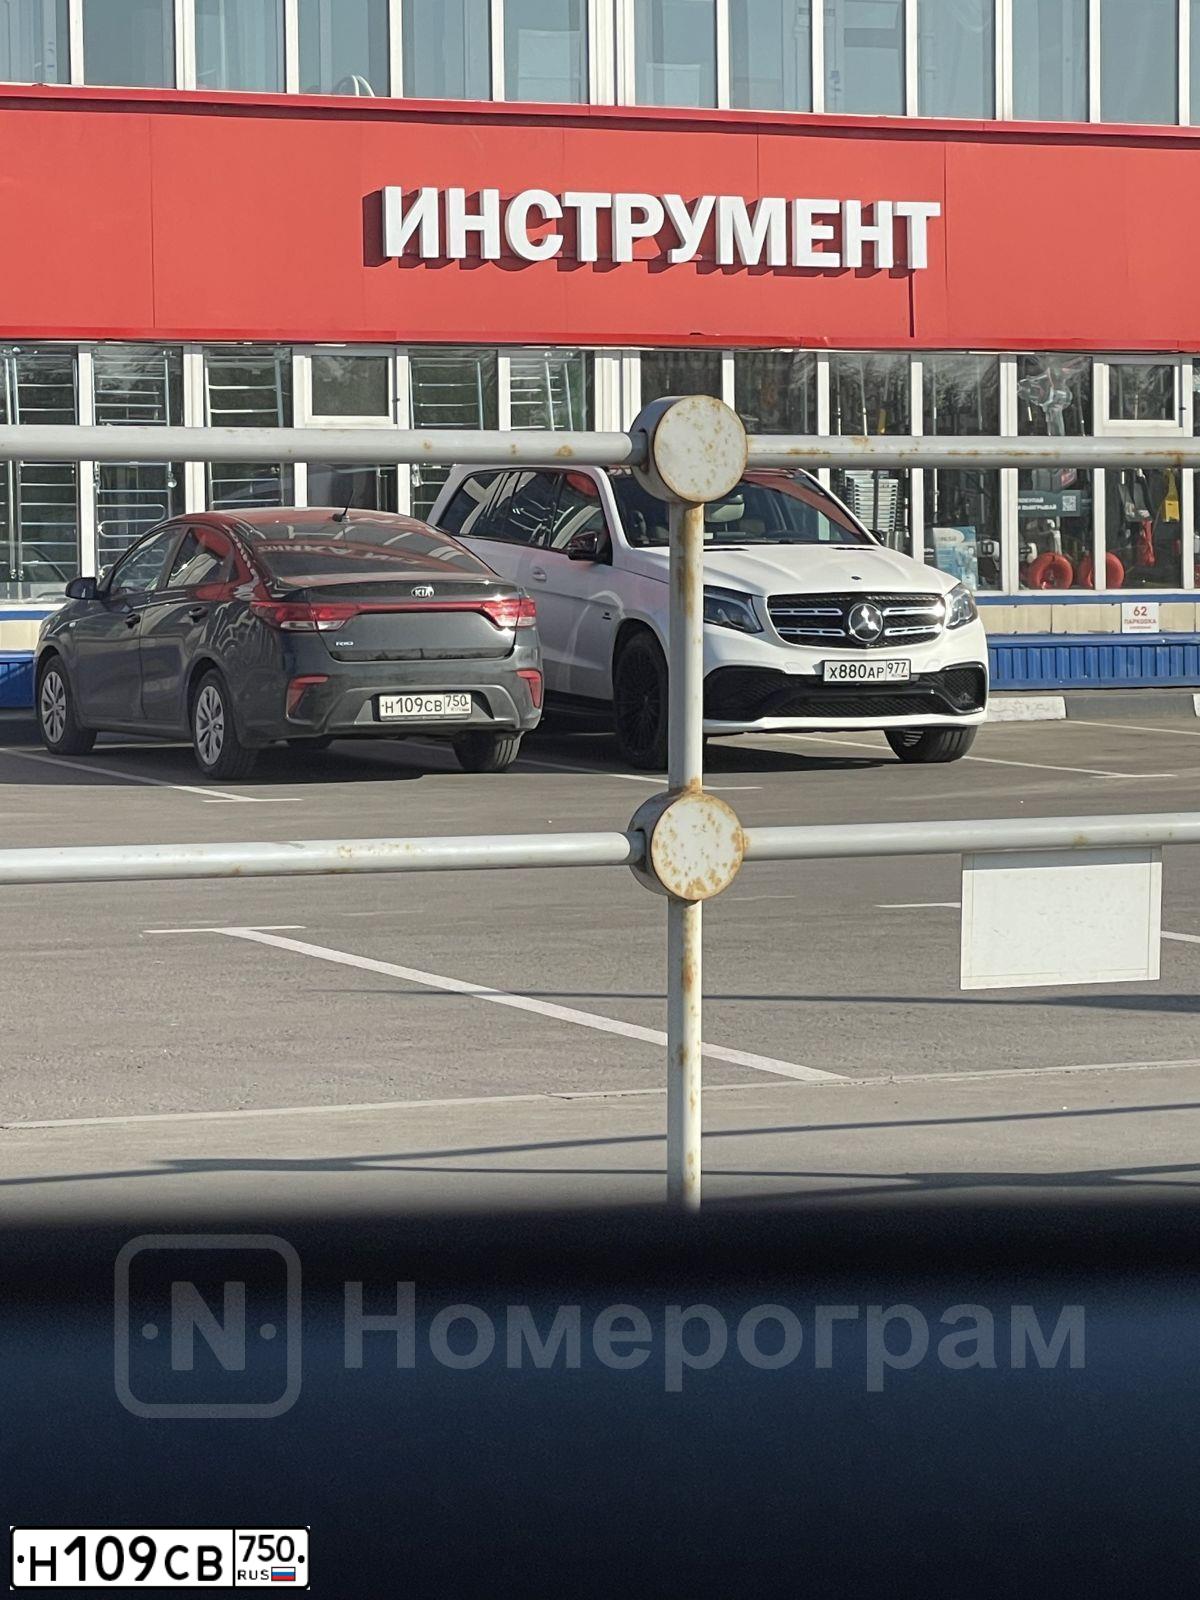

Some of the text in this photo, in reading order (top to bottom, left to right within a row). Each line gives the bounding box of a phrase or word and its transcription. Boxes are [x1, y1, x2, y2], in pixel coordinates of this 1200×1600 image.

[383, 186, 940, 269] ИНСТРУМЕНТ
[414, 587, 433, 598] KIA
[1133, 606, 1147, 616] 62
[887, 662, 907, 674] 977
